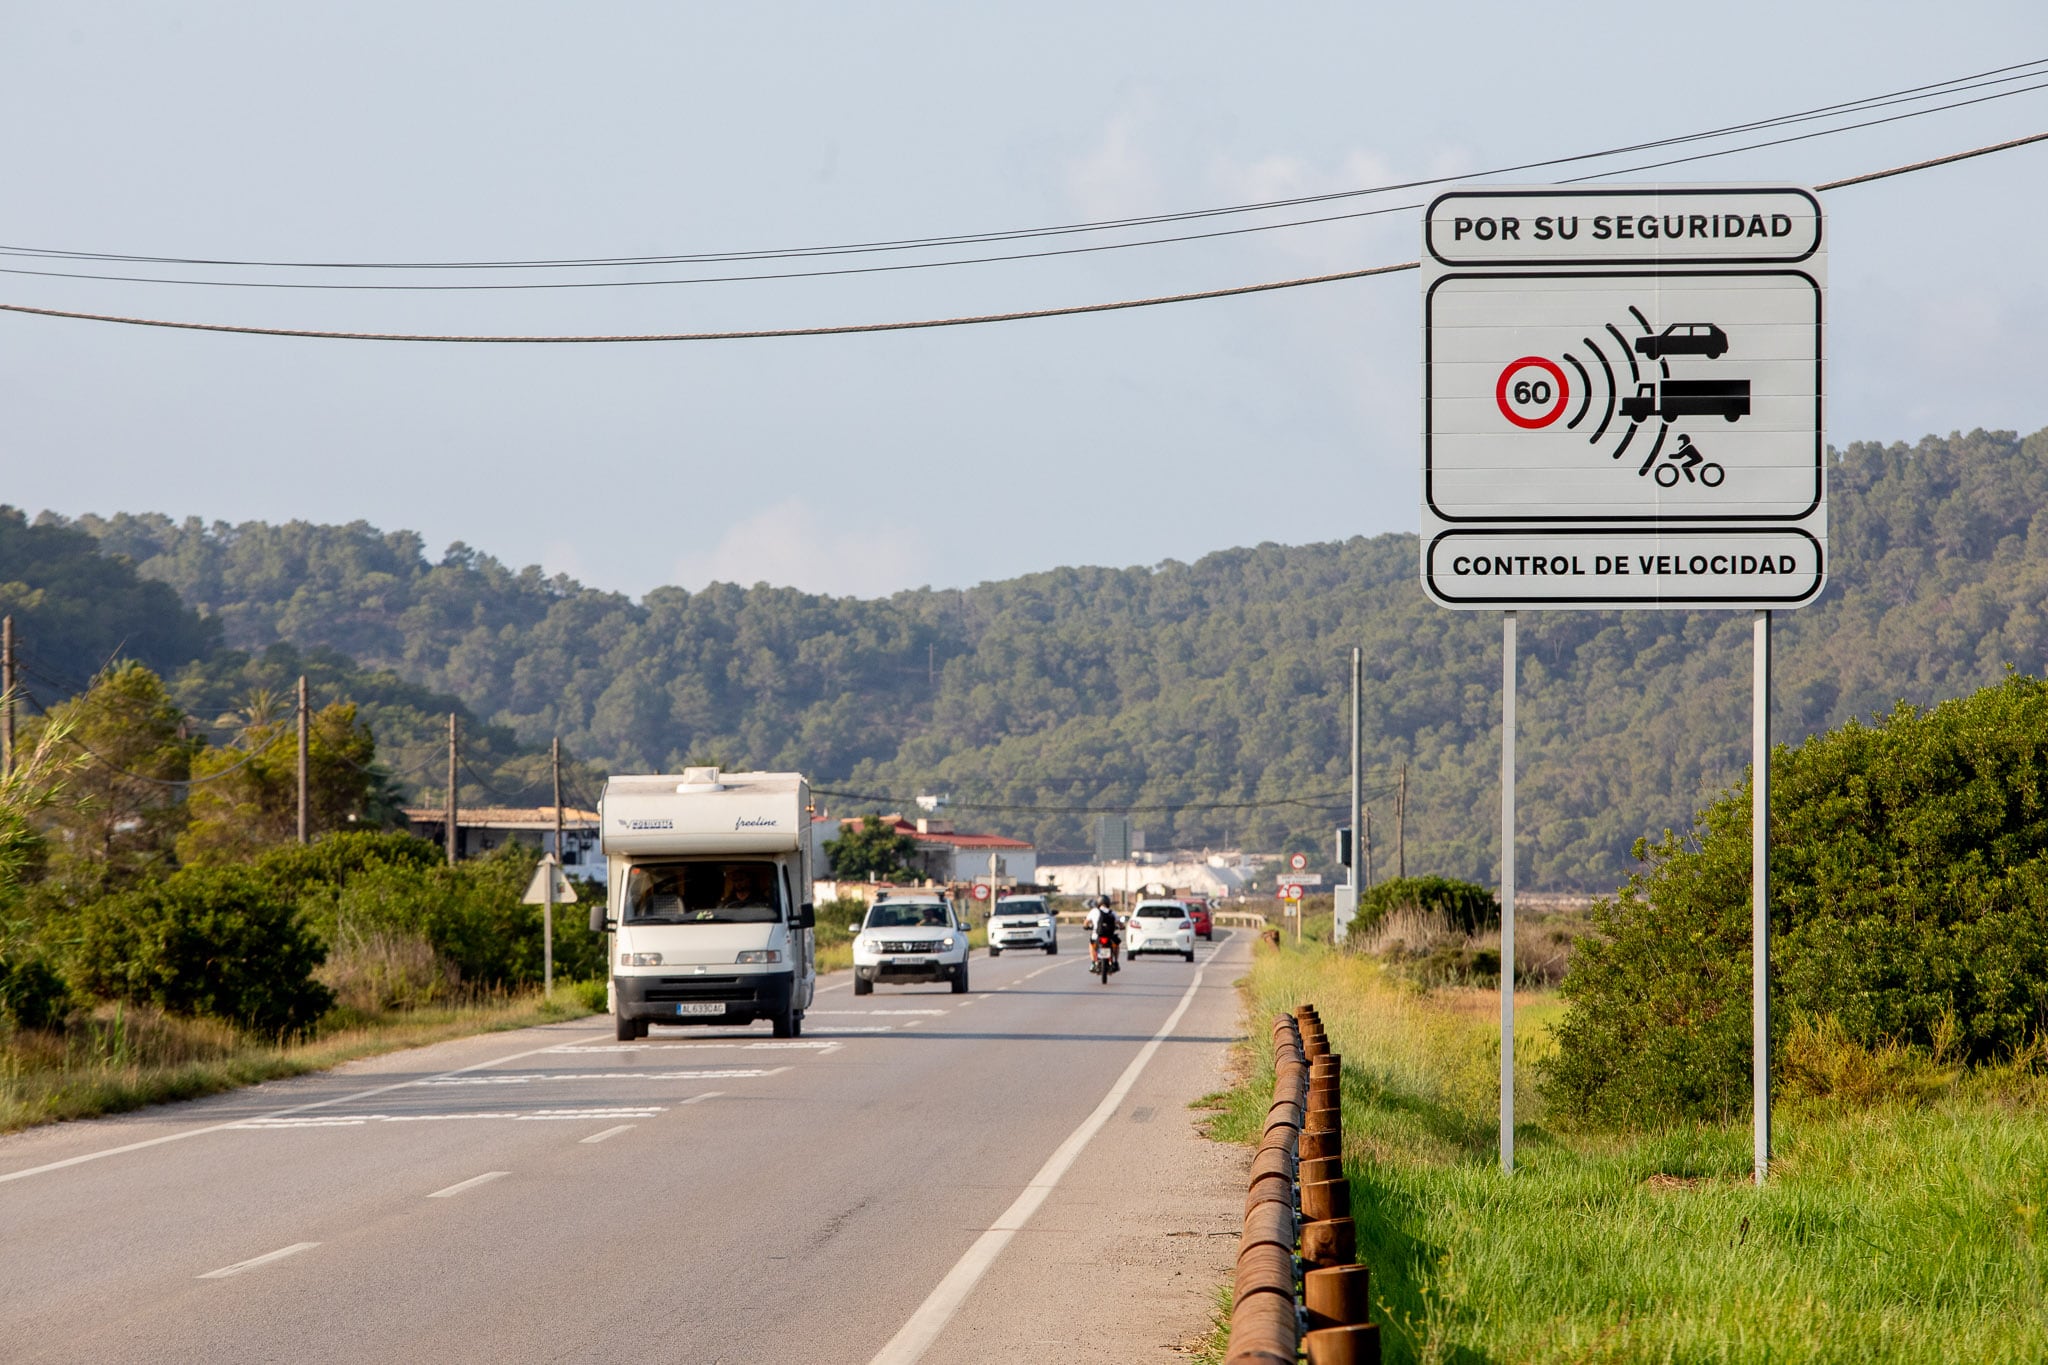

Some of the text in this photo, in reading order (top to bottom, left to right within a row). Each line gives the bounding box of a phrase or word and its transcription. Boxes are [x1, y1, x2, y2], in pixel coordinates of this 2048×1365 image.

[1455, 214, 1791, 240] POR SU SEGURIDAD
[1514, 381, 1551, 404] 60
[1453, 556, 1795, 575] CONTROL DE VELOCIDAD
[734, 816, 777, 831] freeline
